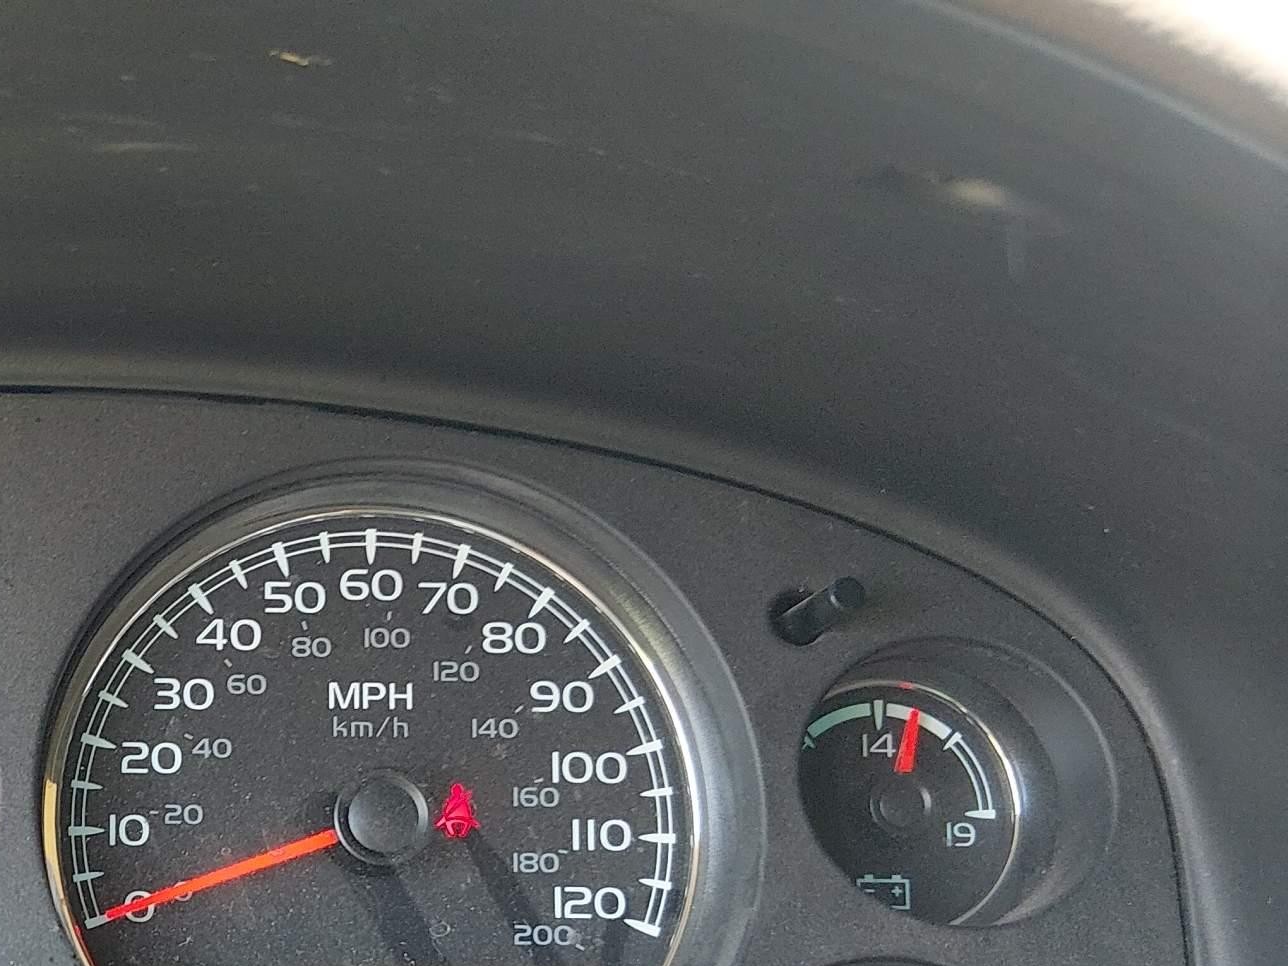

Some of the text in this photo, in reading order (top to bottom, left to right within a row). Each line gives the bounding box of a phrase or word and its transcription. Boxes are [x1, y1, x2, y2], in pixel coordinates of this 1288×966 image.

[264, 581, 327, 614] 50
[339, 569, 403, 601] 60
[418, 582, 479, 615] 70
[195, 619, 262, 651] 40
[291, 636, 332, 658] 80
[363, 627, 410, 649] 100
[481, 621, 546, 655] 80
[227, 673, 267, 695] 60
[432, 661, 479, 683] 120
[153, 677, 214, 711] 30
[328, 682, 413, 709] MPH
[530, 680, 595, 713] 90
[332, 715, 409, 738] km/h
[471, 718, 518, 739] 140
[120, 742, 182, 774] 20
[192, 737, 232, 759] 40
[862, 734, 896, 758] 14
[551, 751, 627, 784] 100
[513, 786, 560, 808] 160
[164, 804, 204, 825] 20
[110, 813, 150, 847] 10
[571, 819, 631, 852] 110
[945, 822, 975, 847] 19
[513, 853, 560, 873] 180
[553, 887, 625, 919] 120
[514, 925, 571, 946] 200
